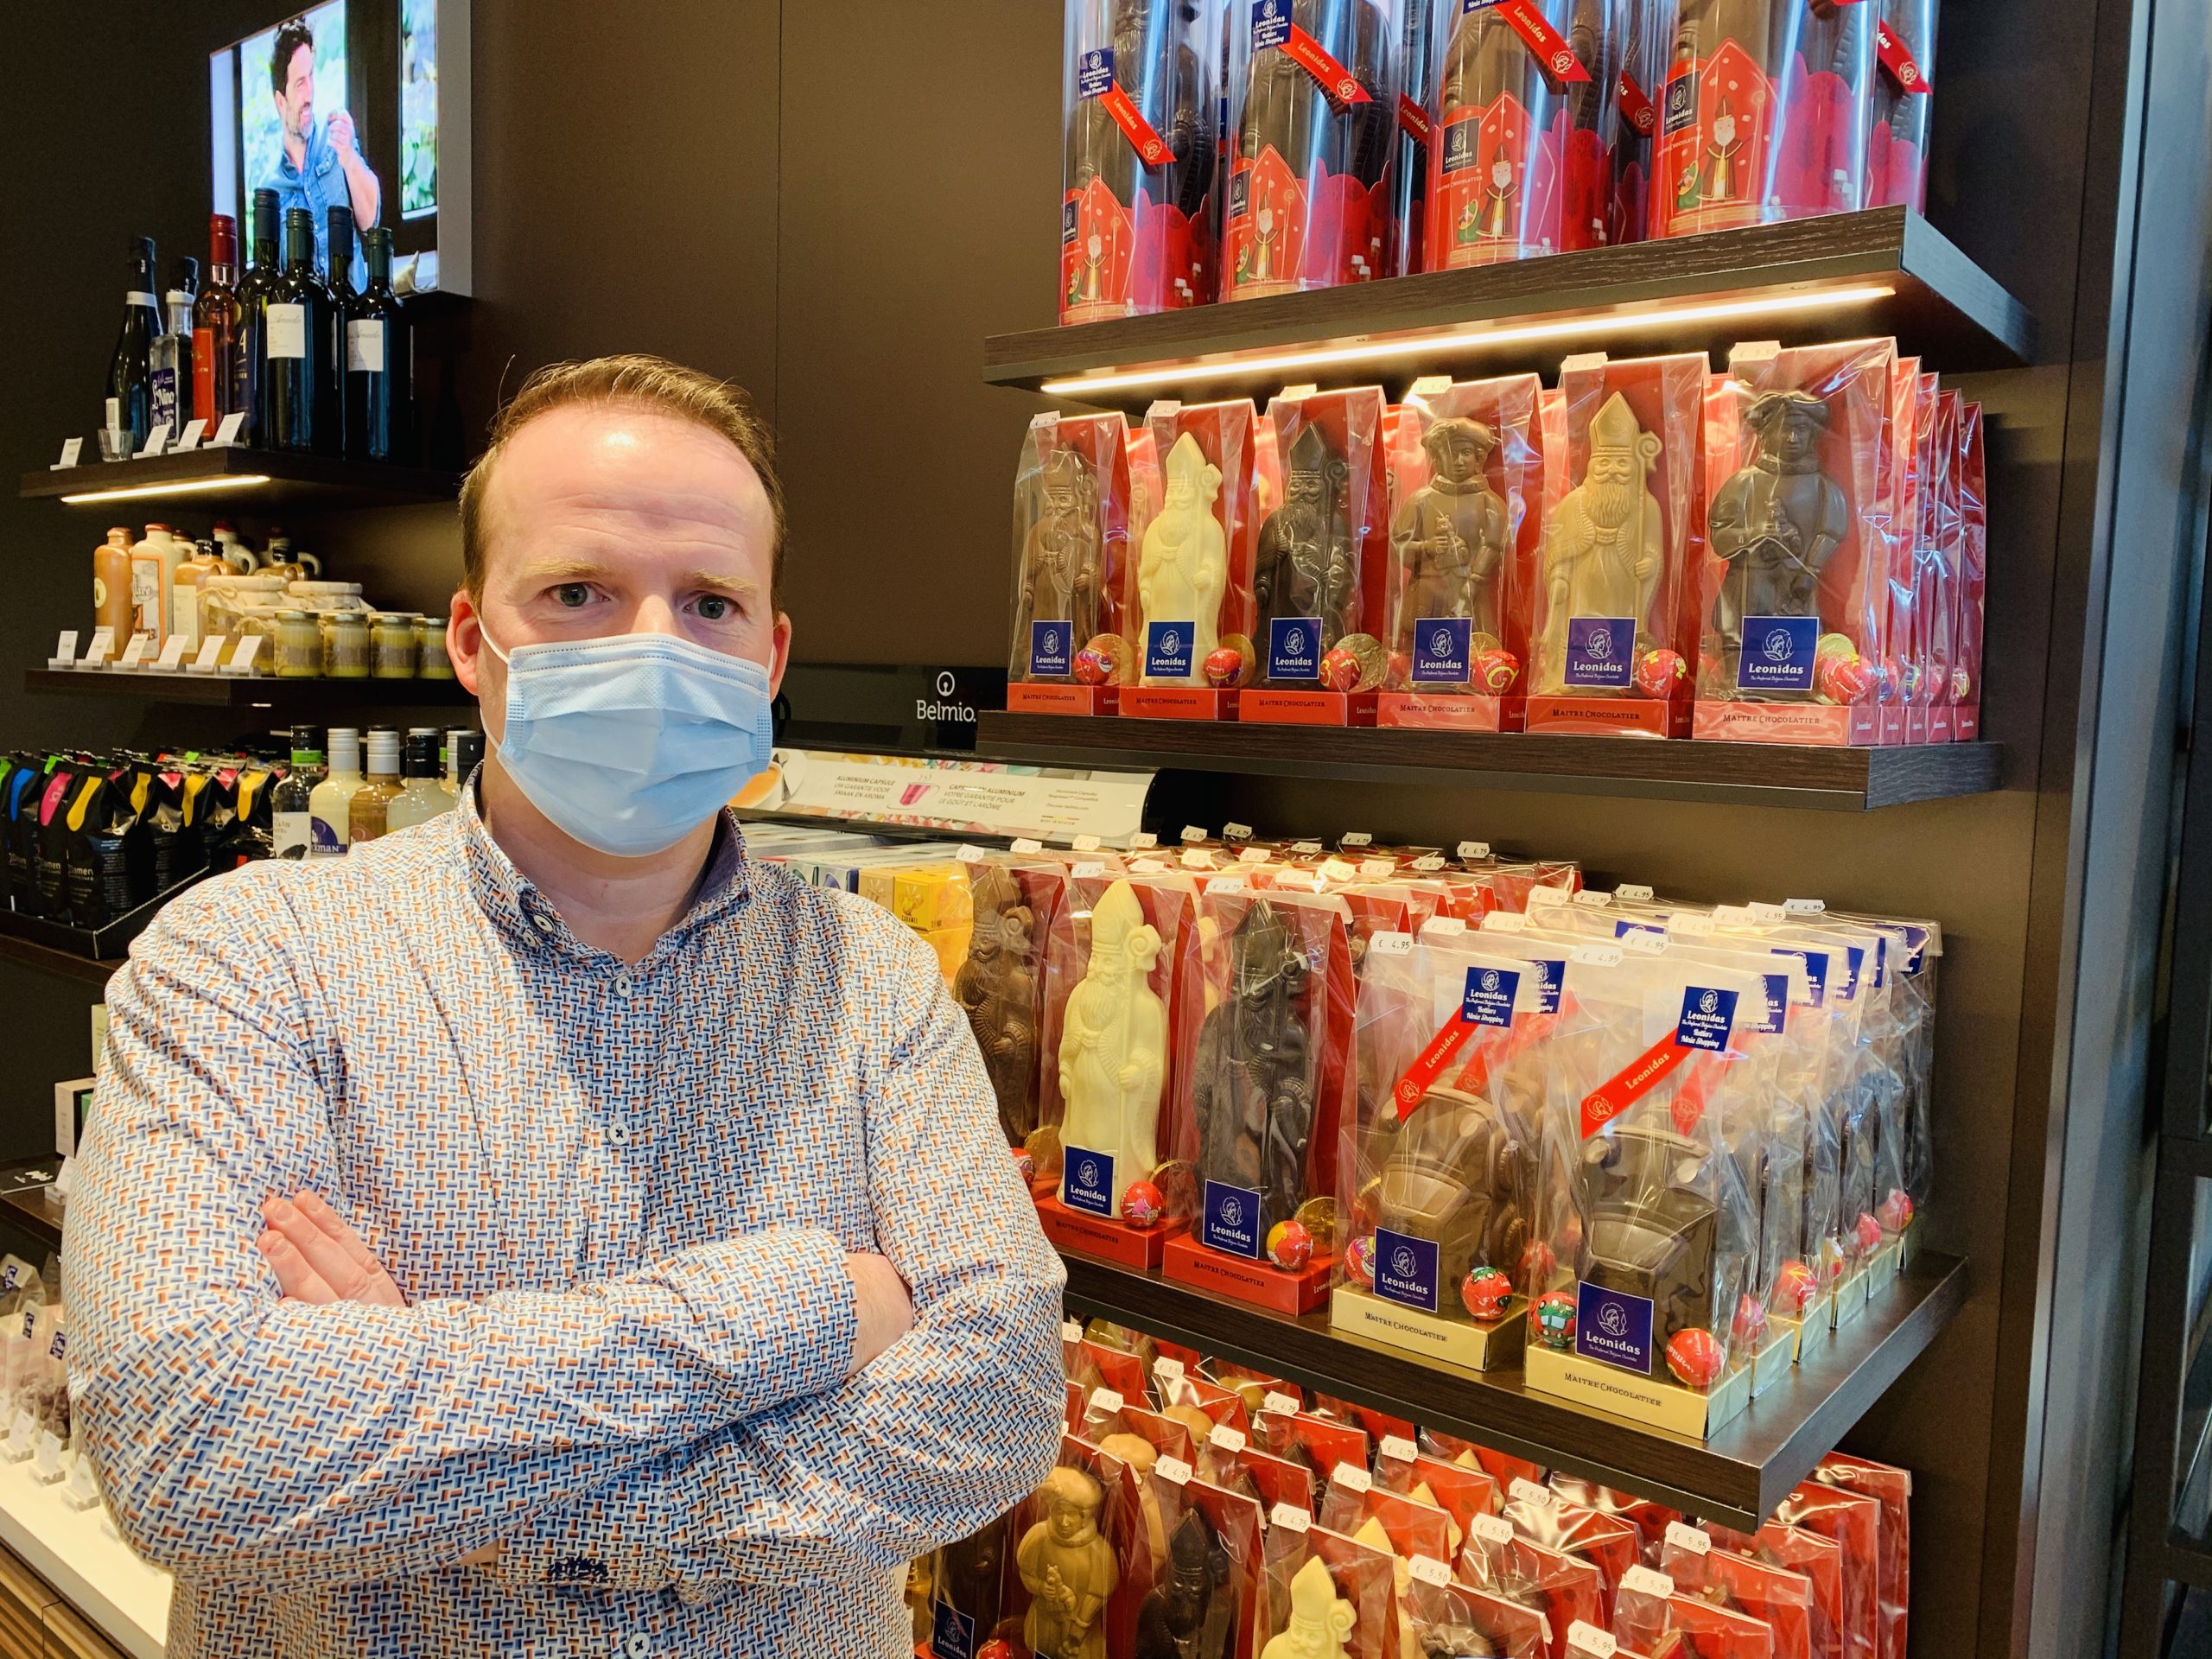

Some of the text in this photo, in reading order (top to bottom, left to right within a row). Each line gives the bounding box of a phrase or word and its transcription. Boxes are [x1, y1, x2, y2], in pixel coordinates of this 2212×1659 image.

[1255, 16, 1286, 29] Leonidas
[1513, 5, 1547, 43] Leonidas
[1298, 42, 1332, 73] Leonidas
[1083, 67, 1109, 79] Leonidas
[1114, 97, 1139, 131] Leonidas
[1399, 104, 1429, 133] Leonidas
[1666, 109, 1694, 126] Leonidas
[1445, 150, 1473, 164] Leonidas
[1035, 655, 1065, 665] Leonidas
[1151, 657, 1186, 667] Leonidas
[1275, 657, 1313, 666] Leonidas
[1420, 659, 1462, 670] Leonidas
[1573, 661, 1623, 672] Leonidas
[1749, 663, 1804, 675] Leonidas
[916, 699, 976, 723] Belmio.
[1552, 709, 1640, 720] MAITRE CHOCOLATIER
[1723, 714, 1821, 724] MAITRE CHOCOLATIER
[1764, 912, 1783, 921] 4.95
[1379, 939, 1410, 950] € 4.95
[1630, 937, 1665, 950] € 4.95
[1598, 953, 1619, 963] 4.95
[1470, 988, 1508, 1001] Leonidas
[1481, 1014, 1504, 1025] Shopping
[1687, 1010, 1726, 1024] Leonidas
[1425, 1030, 1460, 1070] Leonidas
[1696, 1037, 1720, 1050] Shopping
[1624, 1052, 1670, 1090] Leonidas
[1070, 1184, 1107, 1203] Leonidas
[1211, 1222, 1251, 1243] Leonidas
[1220, 1268, 1265, 1287] CHOCOLATIER
[1382, 1272, 1428, 1295] Leonidas
[1364, 1311, 1448, 1343] MAITRE CHOCOLATIER
[1586, 1330, 1641, 1356] Leonidas
[1565, 1372, 1662, 1408] MAITRE CHOCOLATIER
[1280, 1402, 1297, 1413] 4.75
[1398, 1445, 1415, 1458] 4.75
[1162, 1463, 1189, 1480] € 4.75
[1351, 1475, 1369, 1489] 4.75
[1516, 1486, 1547, 1504] € 5.50
[1278, 1513, 1307, 1529] € 4.75
[1479, 1522, 1510, 1539] € 5.50
[1674, 1532, 1707, 1550] € 5.95
[1415, 1564, 1448, 1582] € 5.50
[1635, 1574, 1670, 1593] € 5.95
[938, 1635, 967, 1659] Leonidas
[1577, 1631, 1613, 1653] € 5.95
